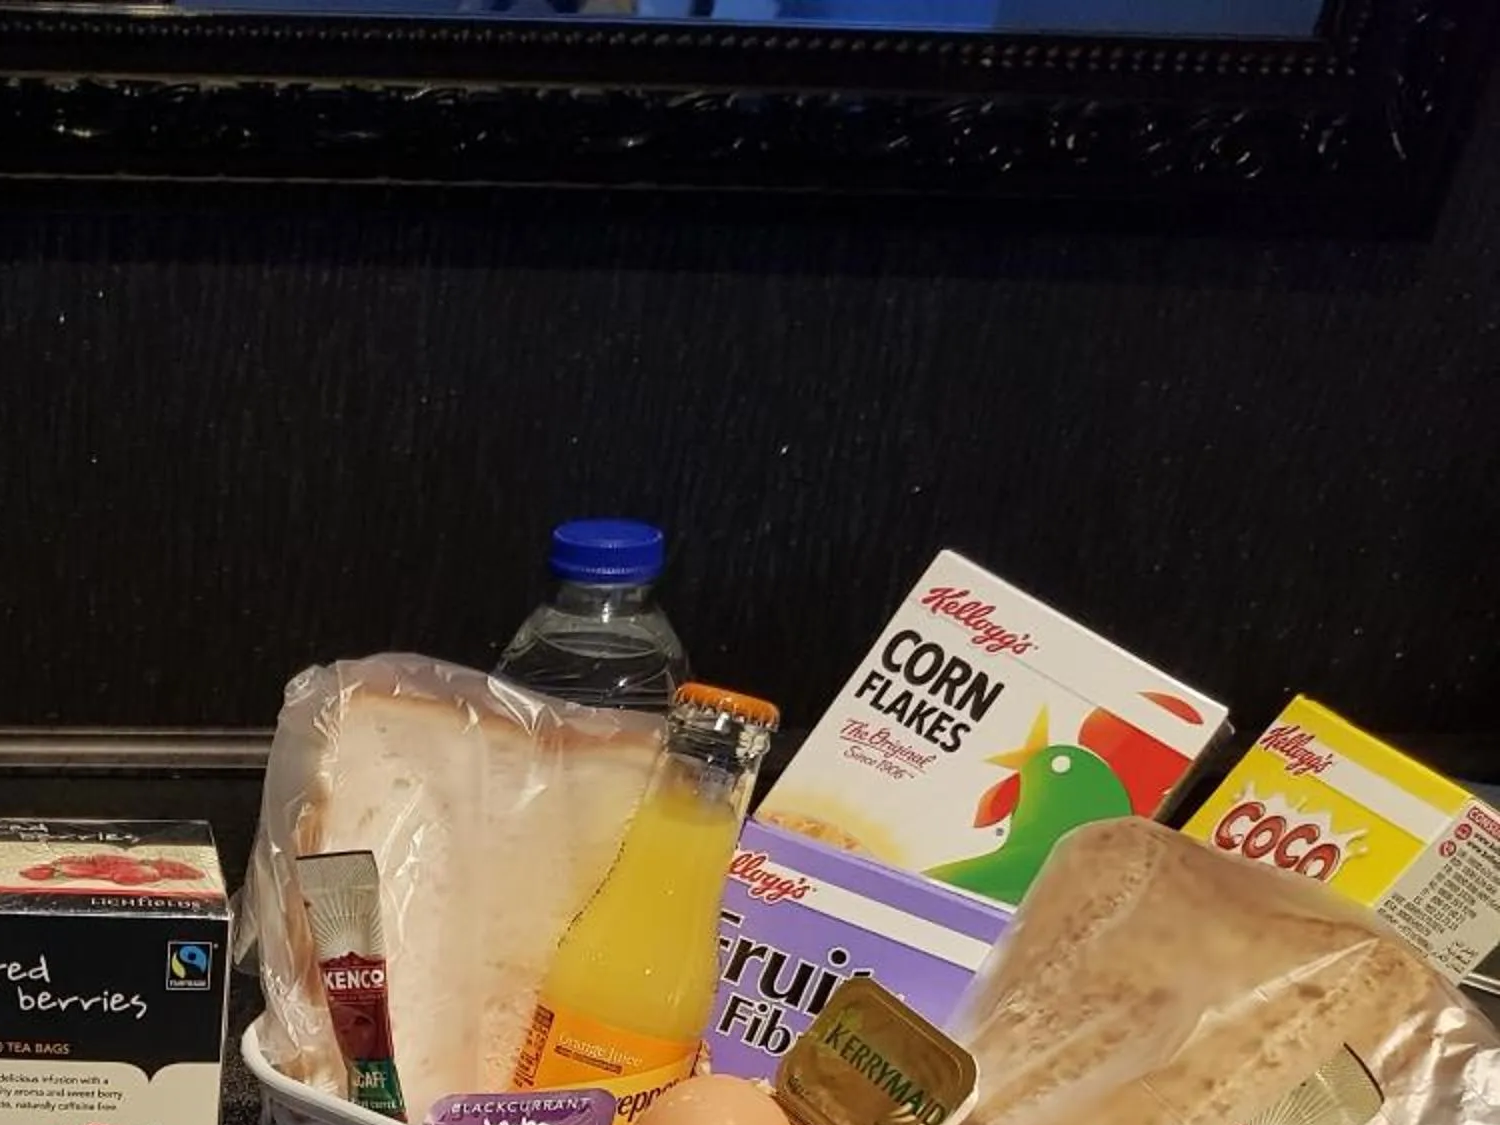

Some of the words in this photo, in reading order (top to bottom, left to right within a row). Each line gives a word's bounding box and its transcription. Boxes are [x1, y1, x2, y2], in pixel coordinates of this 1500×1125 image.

[921, 587, 1035, 655] Kellogg's
[881, 629, 1005, 723] CORN
[854, 669, 971, 753] FLAKES
[1260, 725, 1334, 776] Kellogg's
[16, 985, 148, 1020] berries
[323, 969, 385, 990] KENCO
[6, 1041, 32, 1054] TEA
[34, 1042, 71, 1056] BAGS
[718, 994, 803, 1054] Fib
[451, 1097, 591, 1115] BLACKCURRANT
